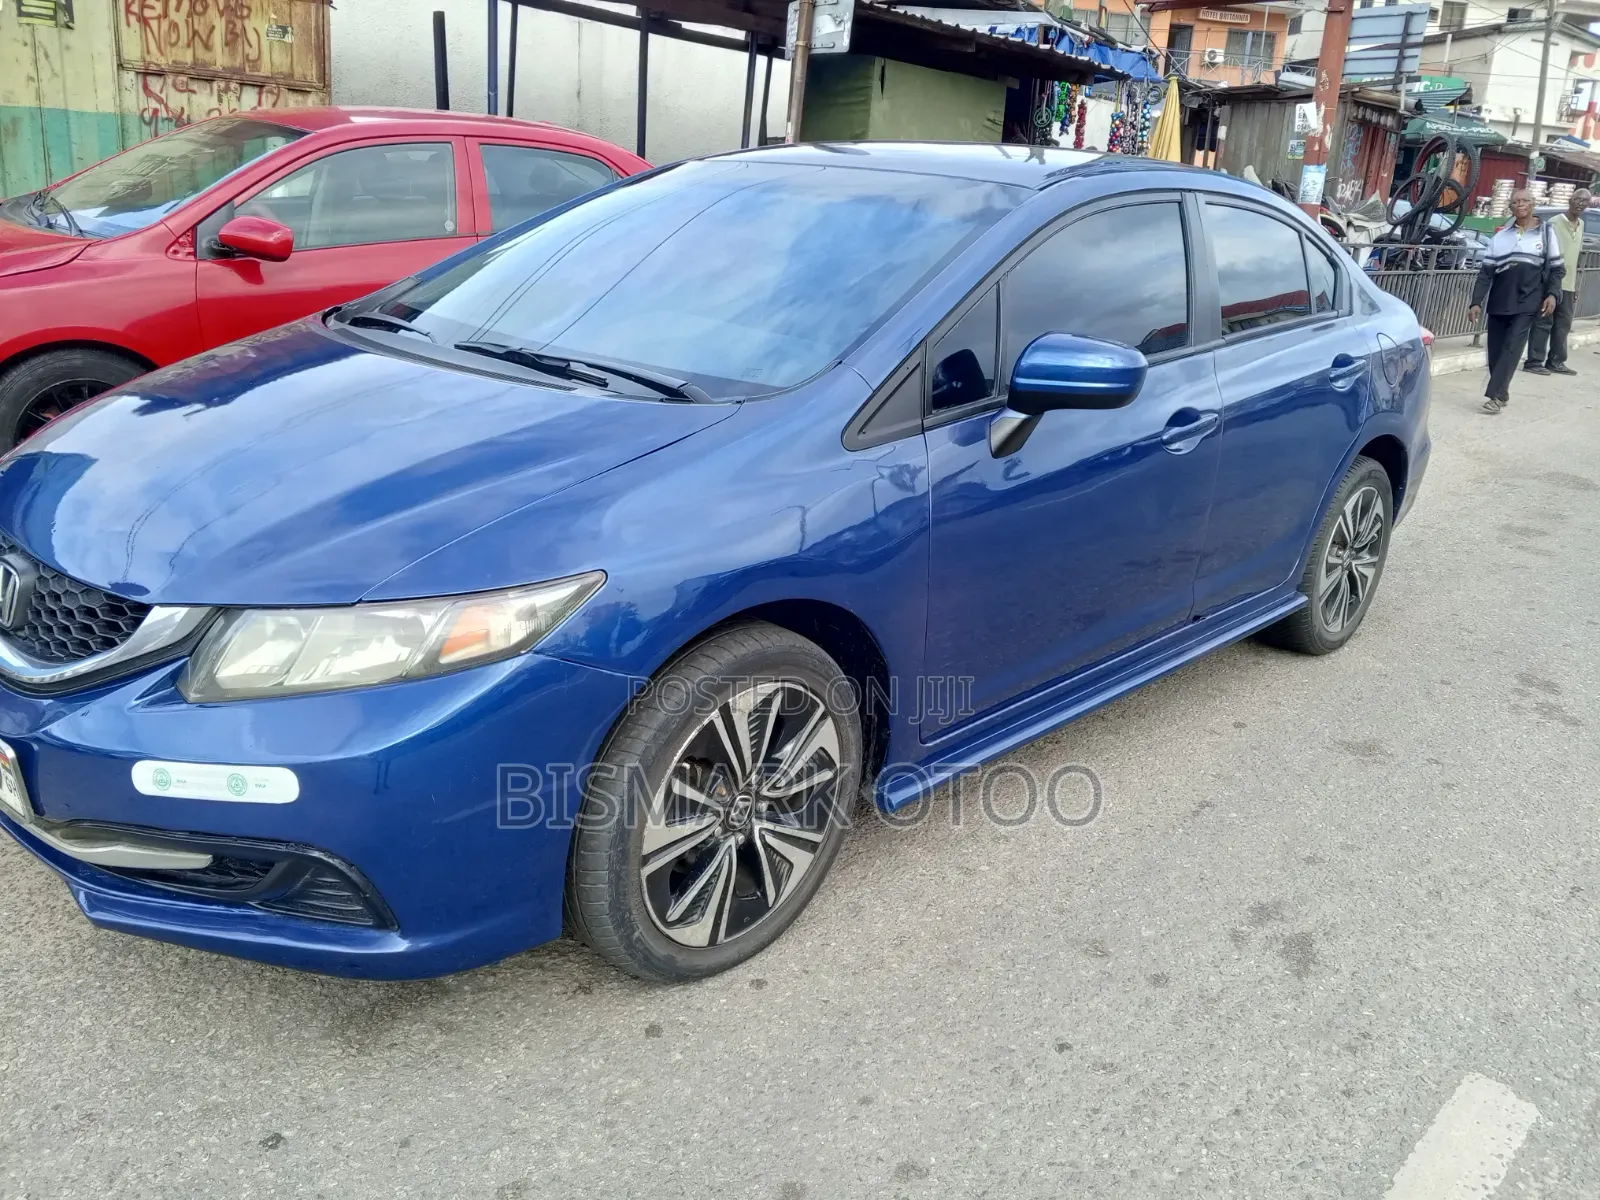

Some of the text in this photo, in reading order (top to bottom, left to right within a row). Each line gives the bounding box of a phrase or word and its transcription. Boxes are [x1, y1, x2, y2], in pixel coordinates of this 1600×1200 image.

[1201, 9, 1249, 22] HOTEL BRITANNIA
[143, 17, 216, 56] NOW
